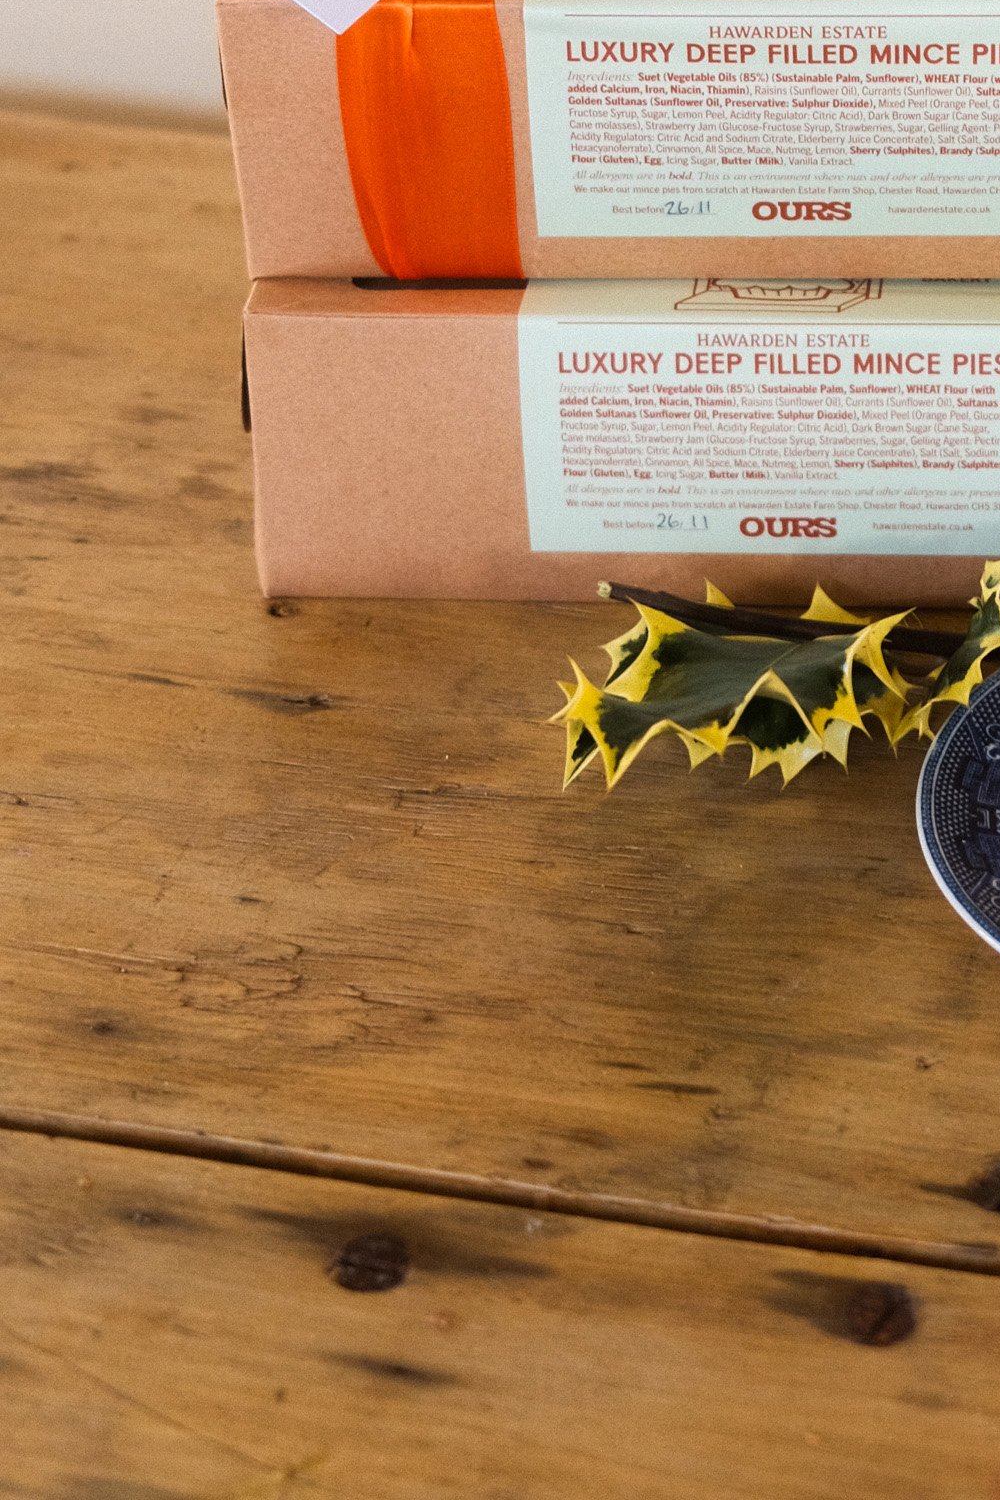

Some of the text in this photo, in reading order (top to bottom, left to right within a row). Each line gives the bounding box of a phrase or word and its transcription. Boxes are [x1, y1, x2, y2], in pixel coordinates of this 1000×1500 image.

[708, 26, 888, 40] HAWARDEN ESTATE
[566, 41, 673, 65] LUXURY
[687, 43, 756, 65] DEEP
[768, 43, 858, 65] FILLED
[870, 44, 960, 65] MINCE
[638, 73, 661, 82] Suet
[663, 74, 716, 85] (Vegetable
[718, 74, 737, 83] Oils
[740, 74, 769, 85] (85%)
[772, 74, 833, 85] (Sustainable
[836, 74, 863, 84] Palm,
[866, 75, 922, 86] Sunflower),
[924, 75, 960, 84] WHEAT
[963, 75, 988, 84] Flour
[567, 86, 598, 94] added
[600, 86, 643, 96] Calcium,
[645, 86, 668, 96] Iron,
[670, 86, 705, 96] Niacin,
[707, 86, 752, 97] Thiamin),
[754, 86, 787, 95] Raisins
[790, 87, 839, 98] (Sunflower
[862, 87, 902, 96] Currants
[904, 87, 952, 98] (Sunflower
[568, 97, 603, 106] Golden
[605, 97, 648, 106] Sultanas
[650, 98, 703, 109] (Sunflower
[706, 98, 722, 108] Oil,
[724, 98, 789, 107] Preservative:
[792, 99, 830, 110] Sulphur
[832, 99, 876, 110] Dioxide),
[878, 99, 906, 108] Mixed
[908, 100, 928, 108] Peel
[930, 100, 966, 111] (Orange
[569, 109, 609, 118] Fructose
[672, 110, 704, 119] Lemon
[730, 110, 762, 121] Acidity
[812, 111, 837, 120] Citric
[868, 111, 890, 120] Dark
[892, 112, 922, 121] Brown
[924, 112, 949, 123] Sugar
[952, 112, 980, 123] (Cane
[569, 121, 960, 135] Cane Strawberry Jam Gelling
[570, 133, 602, 144] Acidity
[657, 134, 681, 143] Citric
[684, 134, 705, 143] Acid
[706, 134, 724, 143] and
[726, 134, 761, 143] Sodium
[798, 134, 846, 146] Elderberry
[848, 135, 872, 144] Juice
[938, 135, 956, 144] Salt
[849, 146, 882, 157] Sherry
[883, 146, 938, 157] (Sulphites),
[939, 147, 974, 158] Brandy
[571, 155, 819, 168] Flour (Gluten), Egg, Icing Butter (Milk), Vanilla
[612, 204, 664, 214] Best before
[752, 202, 852, 222] OURS
[888, 204, 991, 215] hawardenestate.co.uk
[697, 332, 870, 348] HAWARDEN ESTATE
[558, 352, 662, 375] LUXURY
[676, 353, 742, 375] DEEP
[754, 352, 841, 375] FILLED
[854, 353, 941, 375] MINCE
[628, 385, 996, 397] Suet (Vegetable Oils (Sustainable WHEAT Flour (with
[559, 397, 589, 406] added
[956, 399, 999, 408] Sultanas
[560, 410, 815, 422] Golden Sultanas (Sunflower Sulphur
[834, 459, 957, 471] Sherry Brandy
[562, 469, 739, 480] Flour Butter
[740, 517, 837, 538] OURS
